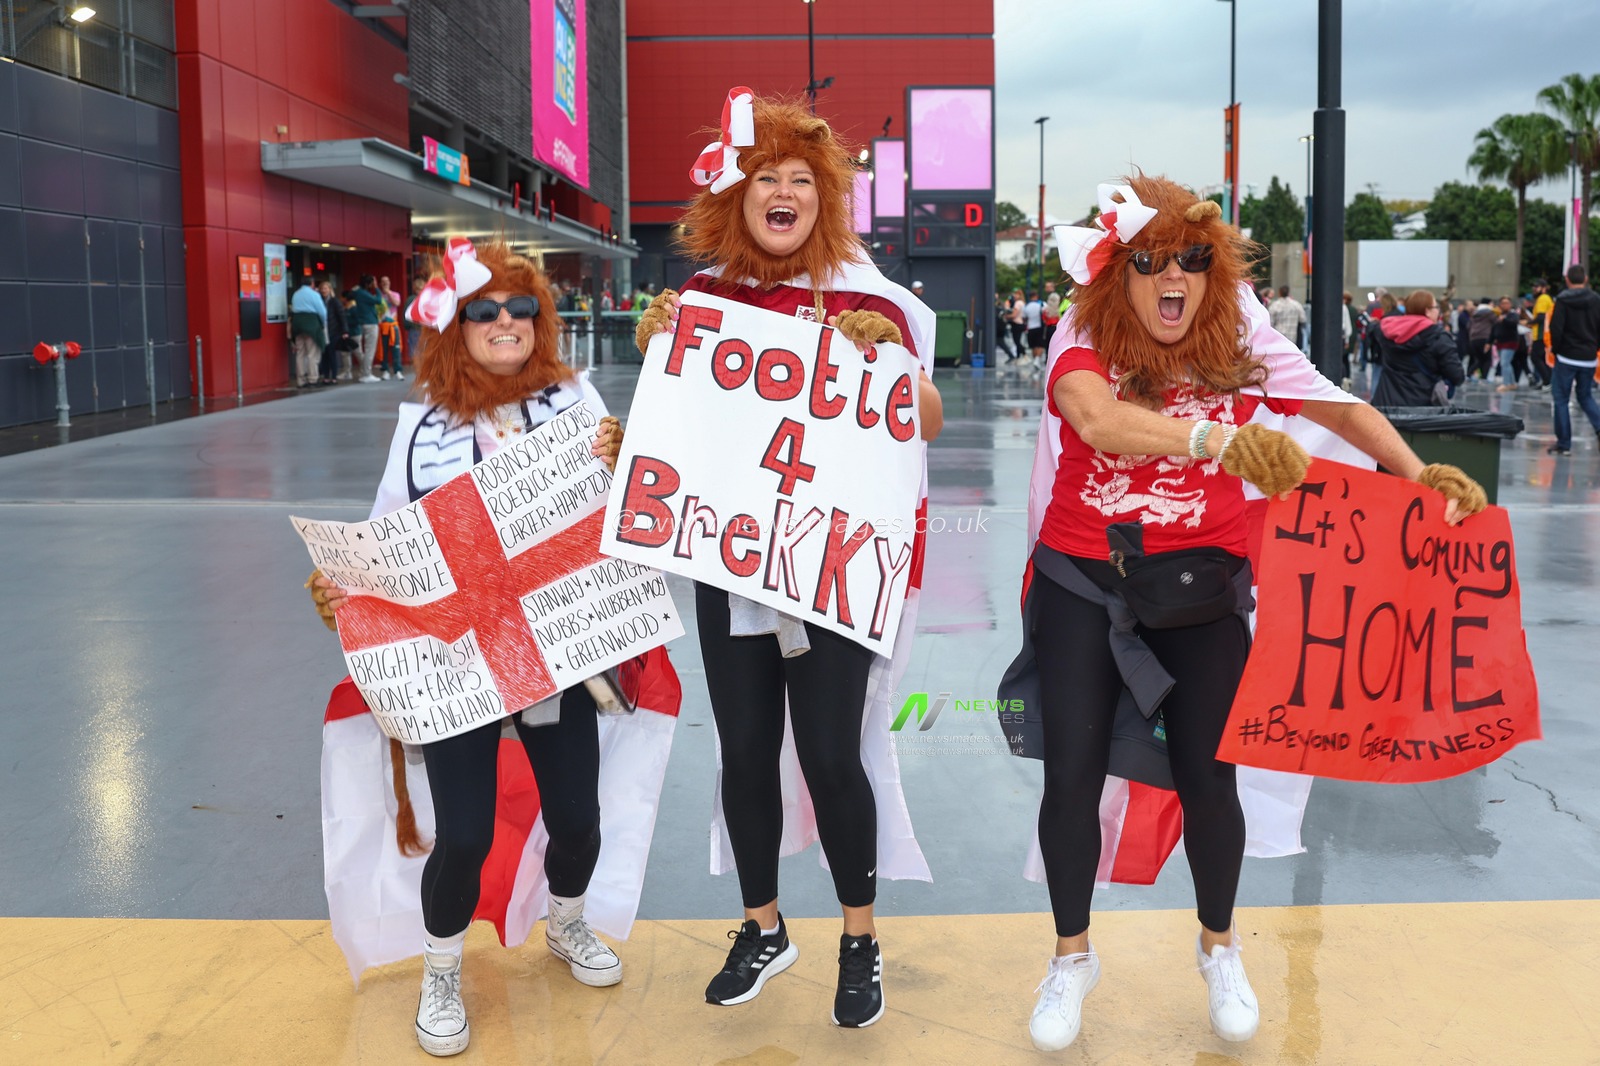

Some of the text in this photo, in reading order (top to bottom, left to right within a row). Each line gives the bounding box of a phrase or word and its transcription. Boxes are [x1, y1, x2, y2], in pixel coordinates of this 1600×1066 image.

[965, 203, 983, 227] D
[665, 304, 916, 442] Footie
[473, 403, 597, 495] ROBINSON COOMBS
[760, 417, 816, 497] 4
[488, 467, 554, 522] ROEBUCK
[500, 468, 613, 549] CARTER HAMPTON
[295, 503, 423, 546] KELLY DALY
[309, 531, 435, 571] JAMES HEMP
[377, 560, 449, 598] BRONZE
[522, 575, 585, 623] STANWAY
[535, 576, 666, 650] NOBBS WUBBEN-MOY
[350, 634, 476, 685] BRIGHT WALSH
[565, 613, 659, 671] GREENWOOD
[1286, 572, 1506, 713] HOME
[362, 662, 482, 713] TOONE EARPS
[429, 689, 502, 736] ENGLAND
